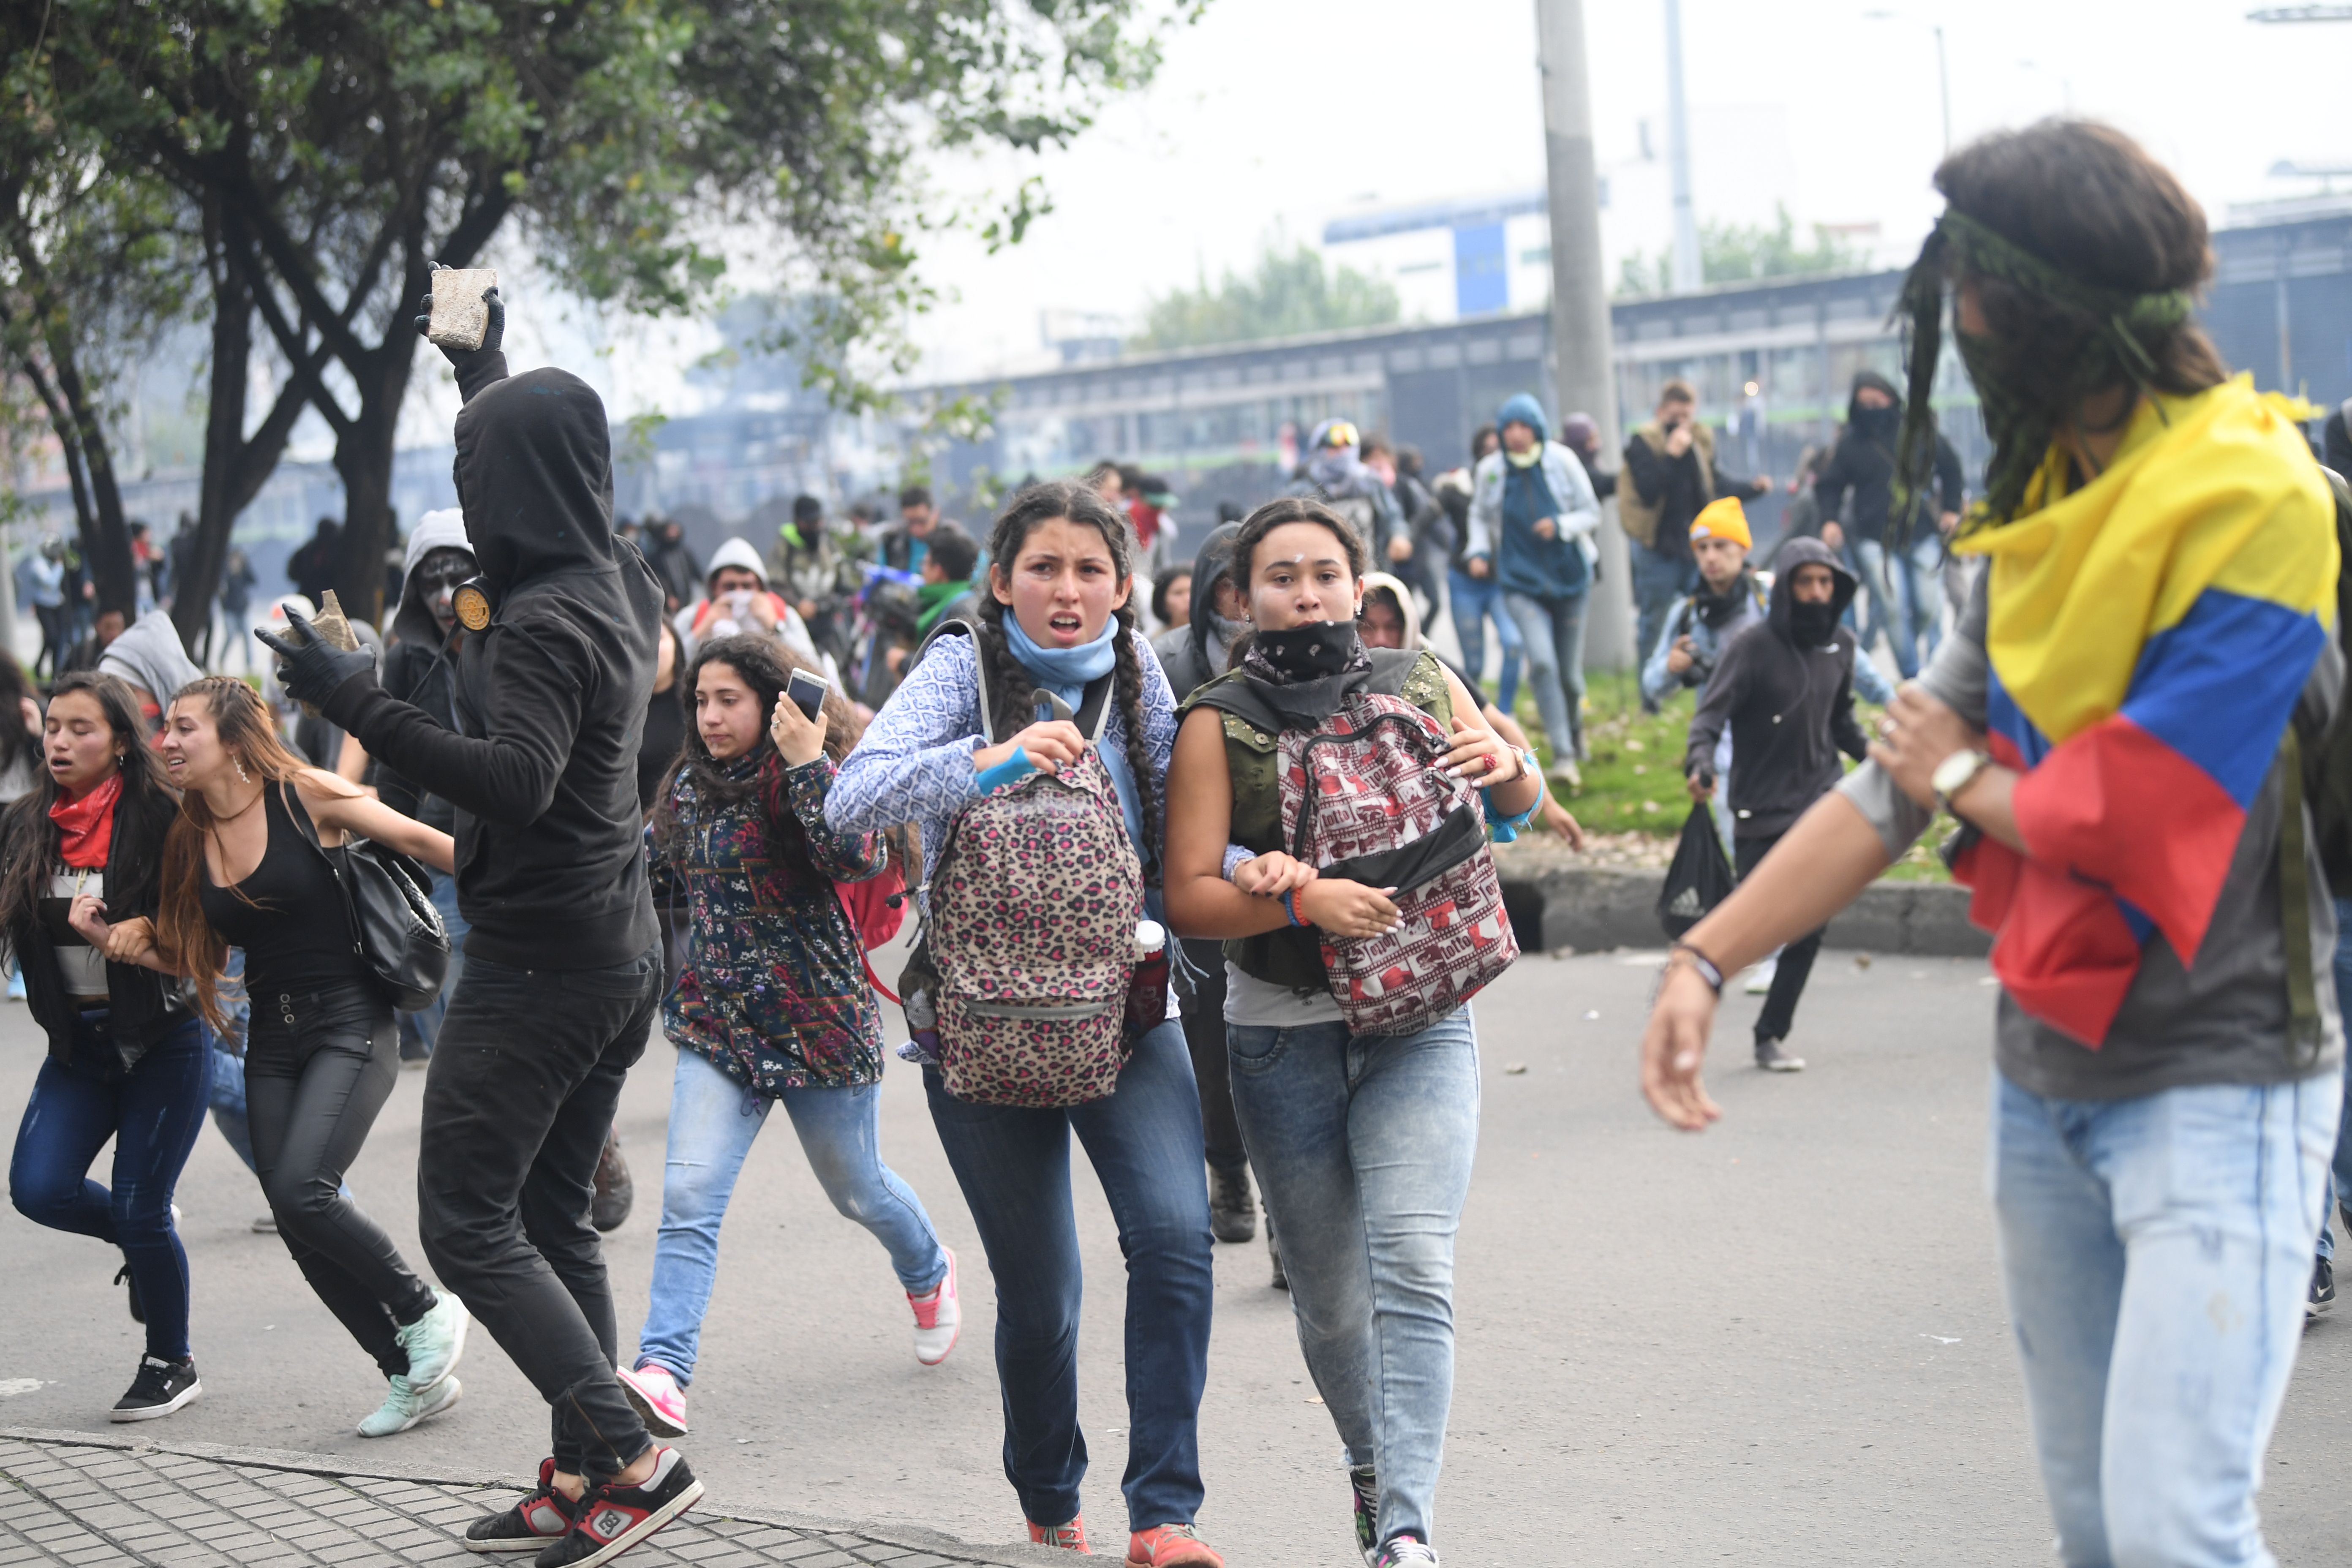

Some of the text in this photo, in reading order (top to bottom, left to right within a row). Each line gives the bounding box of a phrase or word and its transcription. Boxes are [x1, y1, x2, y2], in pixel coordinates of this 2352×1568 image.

[1322, 809, 1350, 827] totto
[1370, 934, 1396, 956] totto
[1440, 936, 1472, 960] totto
